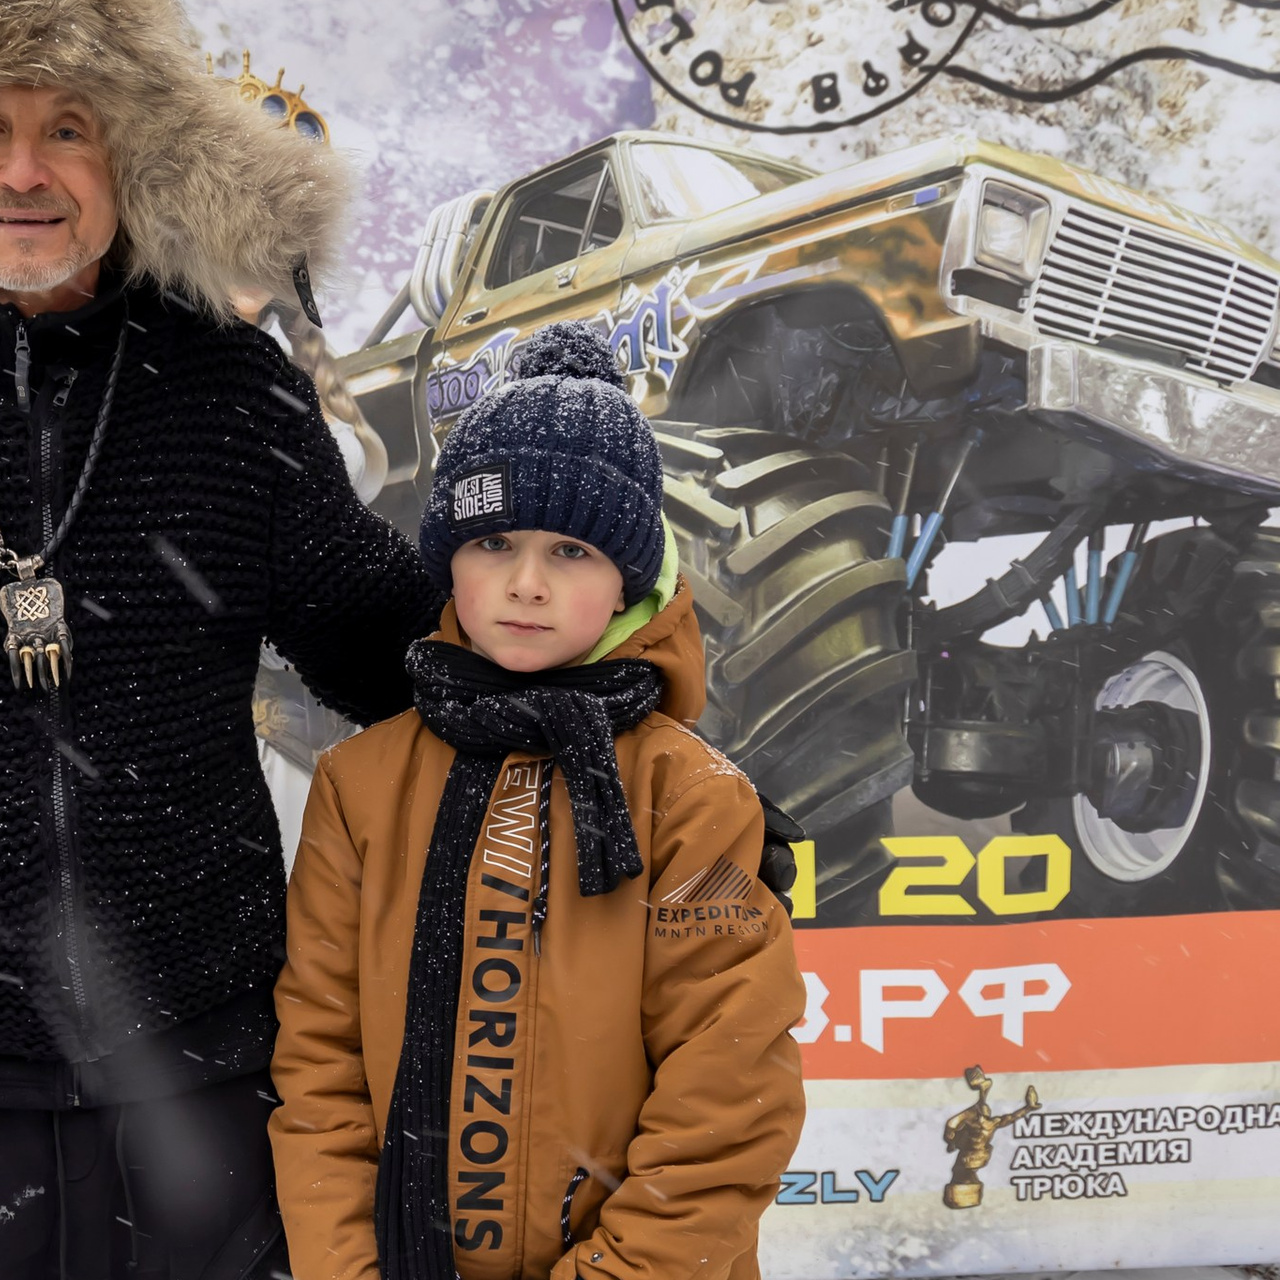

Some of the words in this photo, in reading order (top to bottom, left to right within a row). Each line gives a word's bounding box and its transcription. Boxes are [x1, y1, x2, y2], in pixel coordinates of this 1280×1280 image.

[454, 473, 483, 500] WEST
[482, 472, 503, 514] STORY
[453, 493, 484, 521] SIDE
[878, 833, 1072, 916] 20
[654, 925, 707, 939] MNTN
[1011, 1139, 1191, 1170] АКАДЕМИЯ
[1010, 1173, 1127, 1201] ТРЮКА
